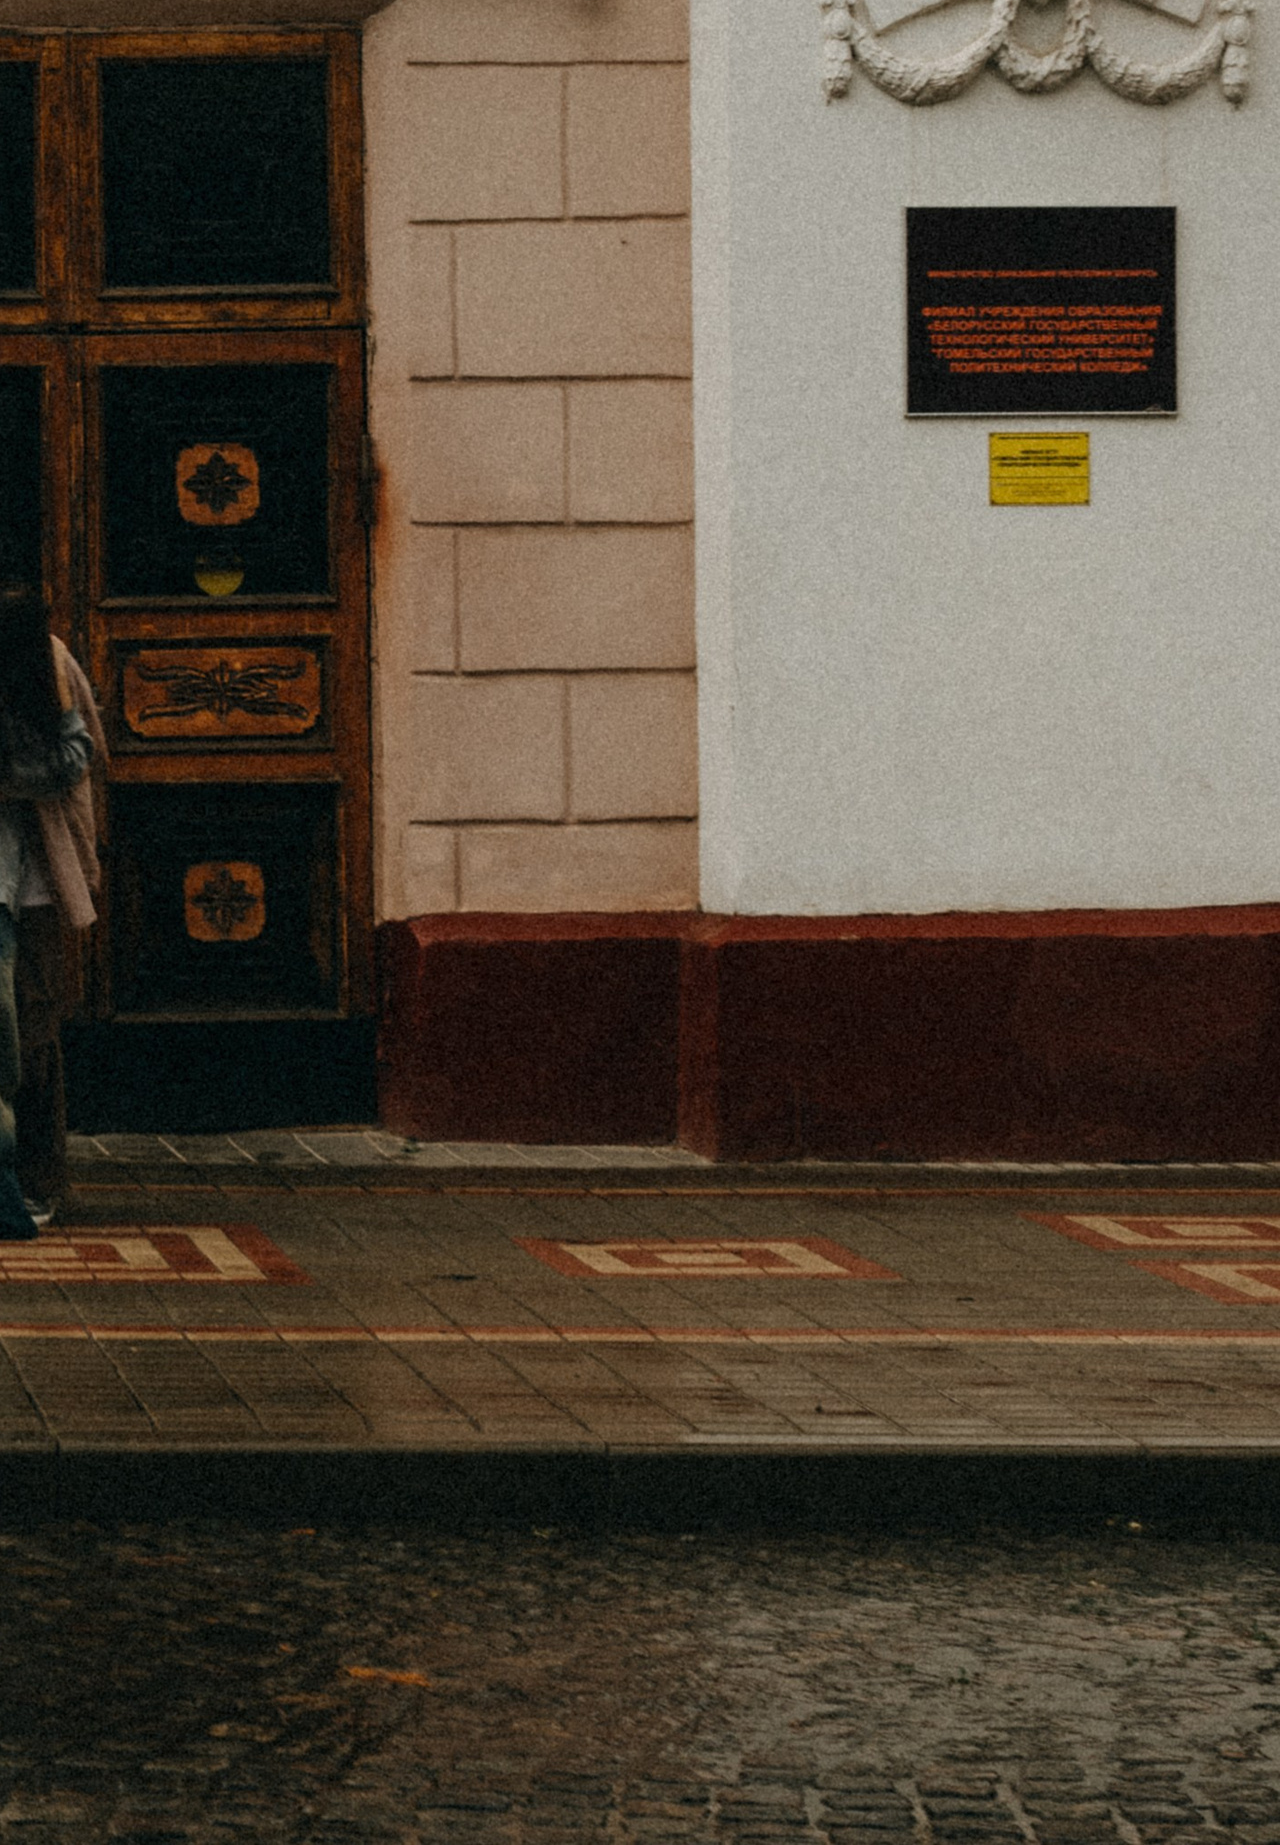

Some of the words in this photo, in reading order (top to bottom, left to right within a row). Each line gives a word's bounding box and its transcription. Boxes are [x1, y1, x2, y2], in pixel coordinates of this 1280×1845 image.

[921, 306, 976, 317] ФИЛИАЛ
[979, 306, 1065, 317] УЧРЕЖДЕНИЯ
[1067, 305, 1163, 316] ОБРАЗОВАНИЯ
[1029, 319, 1158, 331] ГОСУДАРСТВЕННЫЙ
[930, 334, 1055, 345] ТЕХНОЛОГИЧЕСКИЙ
[1025, 347, 1154, 359] ГОСУДАРСТВЕННЫЙ
[949, 361, 1077, 373] ПОЛИТЕХНИЧЕСКИЙ
